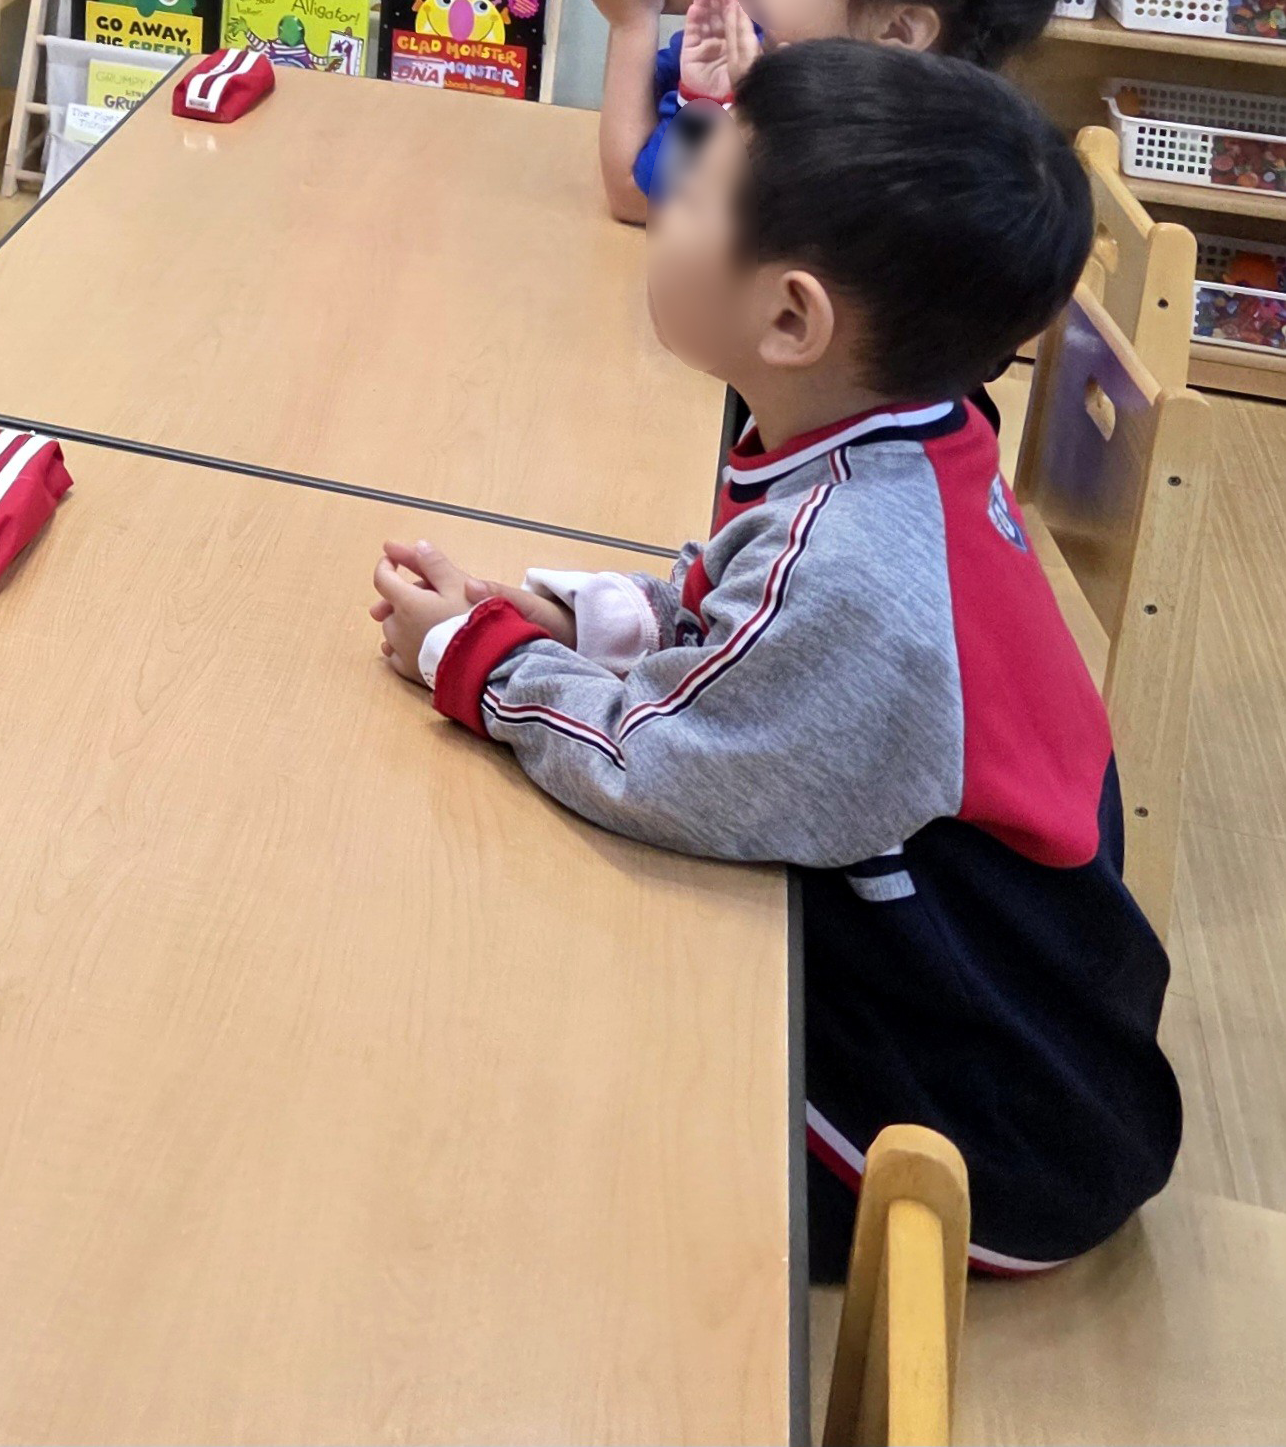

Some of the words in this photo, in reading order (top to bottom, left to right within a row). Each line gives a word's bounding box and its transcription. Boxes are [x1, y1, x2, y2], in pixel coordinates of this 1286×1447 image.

[96, 16, 122, 30] GO
[129, 21, 191, 45] AWAY,
[397, 36, 441, 54] GLAD
[397, 65, 439, 83] DNA
